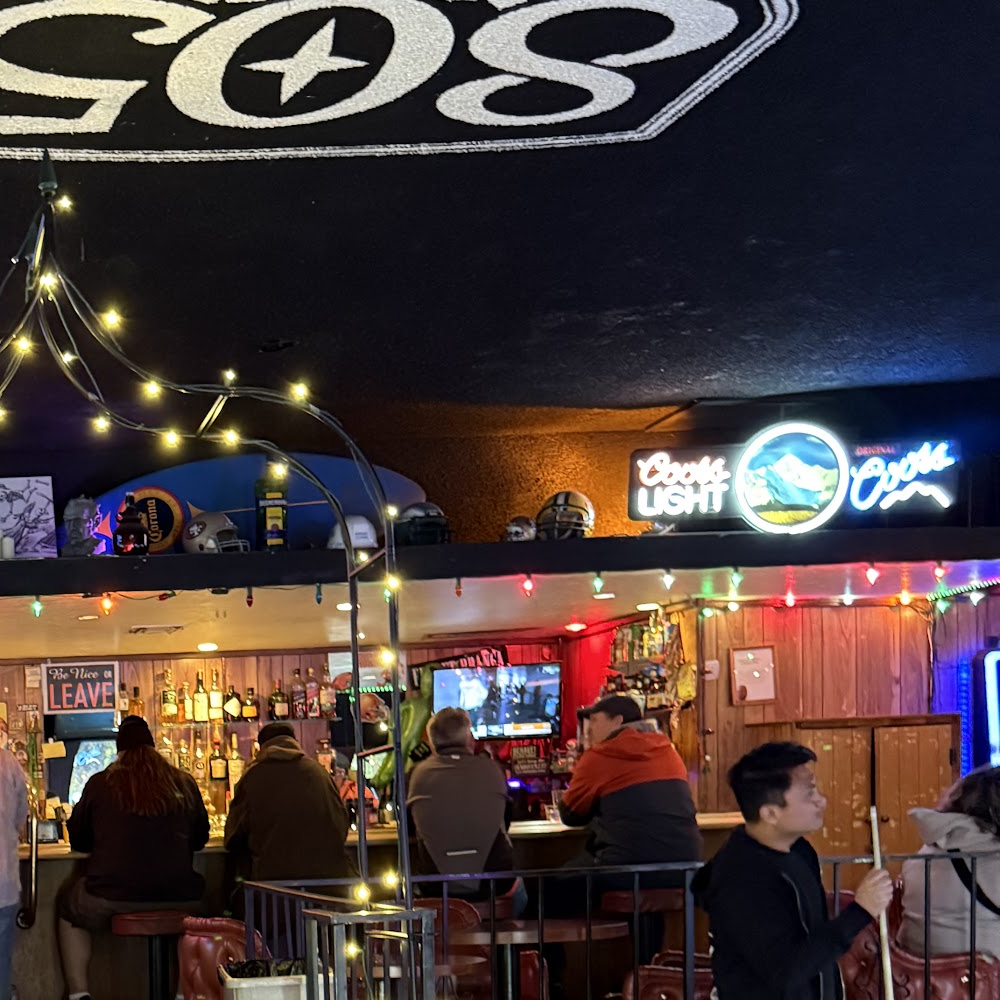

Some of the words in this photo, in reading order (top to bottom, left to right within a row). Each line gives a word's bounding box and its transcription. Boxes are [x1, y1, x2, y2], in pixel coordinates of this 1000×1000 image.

[637, 451, 732, 489] Coors
[850, 441, 957, 512] Coors
[637, 482, 730, 517] LIGHT
[146, 498, 164, 544] Corona
[48, 668, 70, 680] Be
[70, 667, 99, 680] Nice
[49, 682, 114, 709] LEAVE
